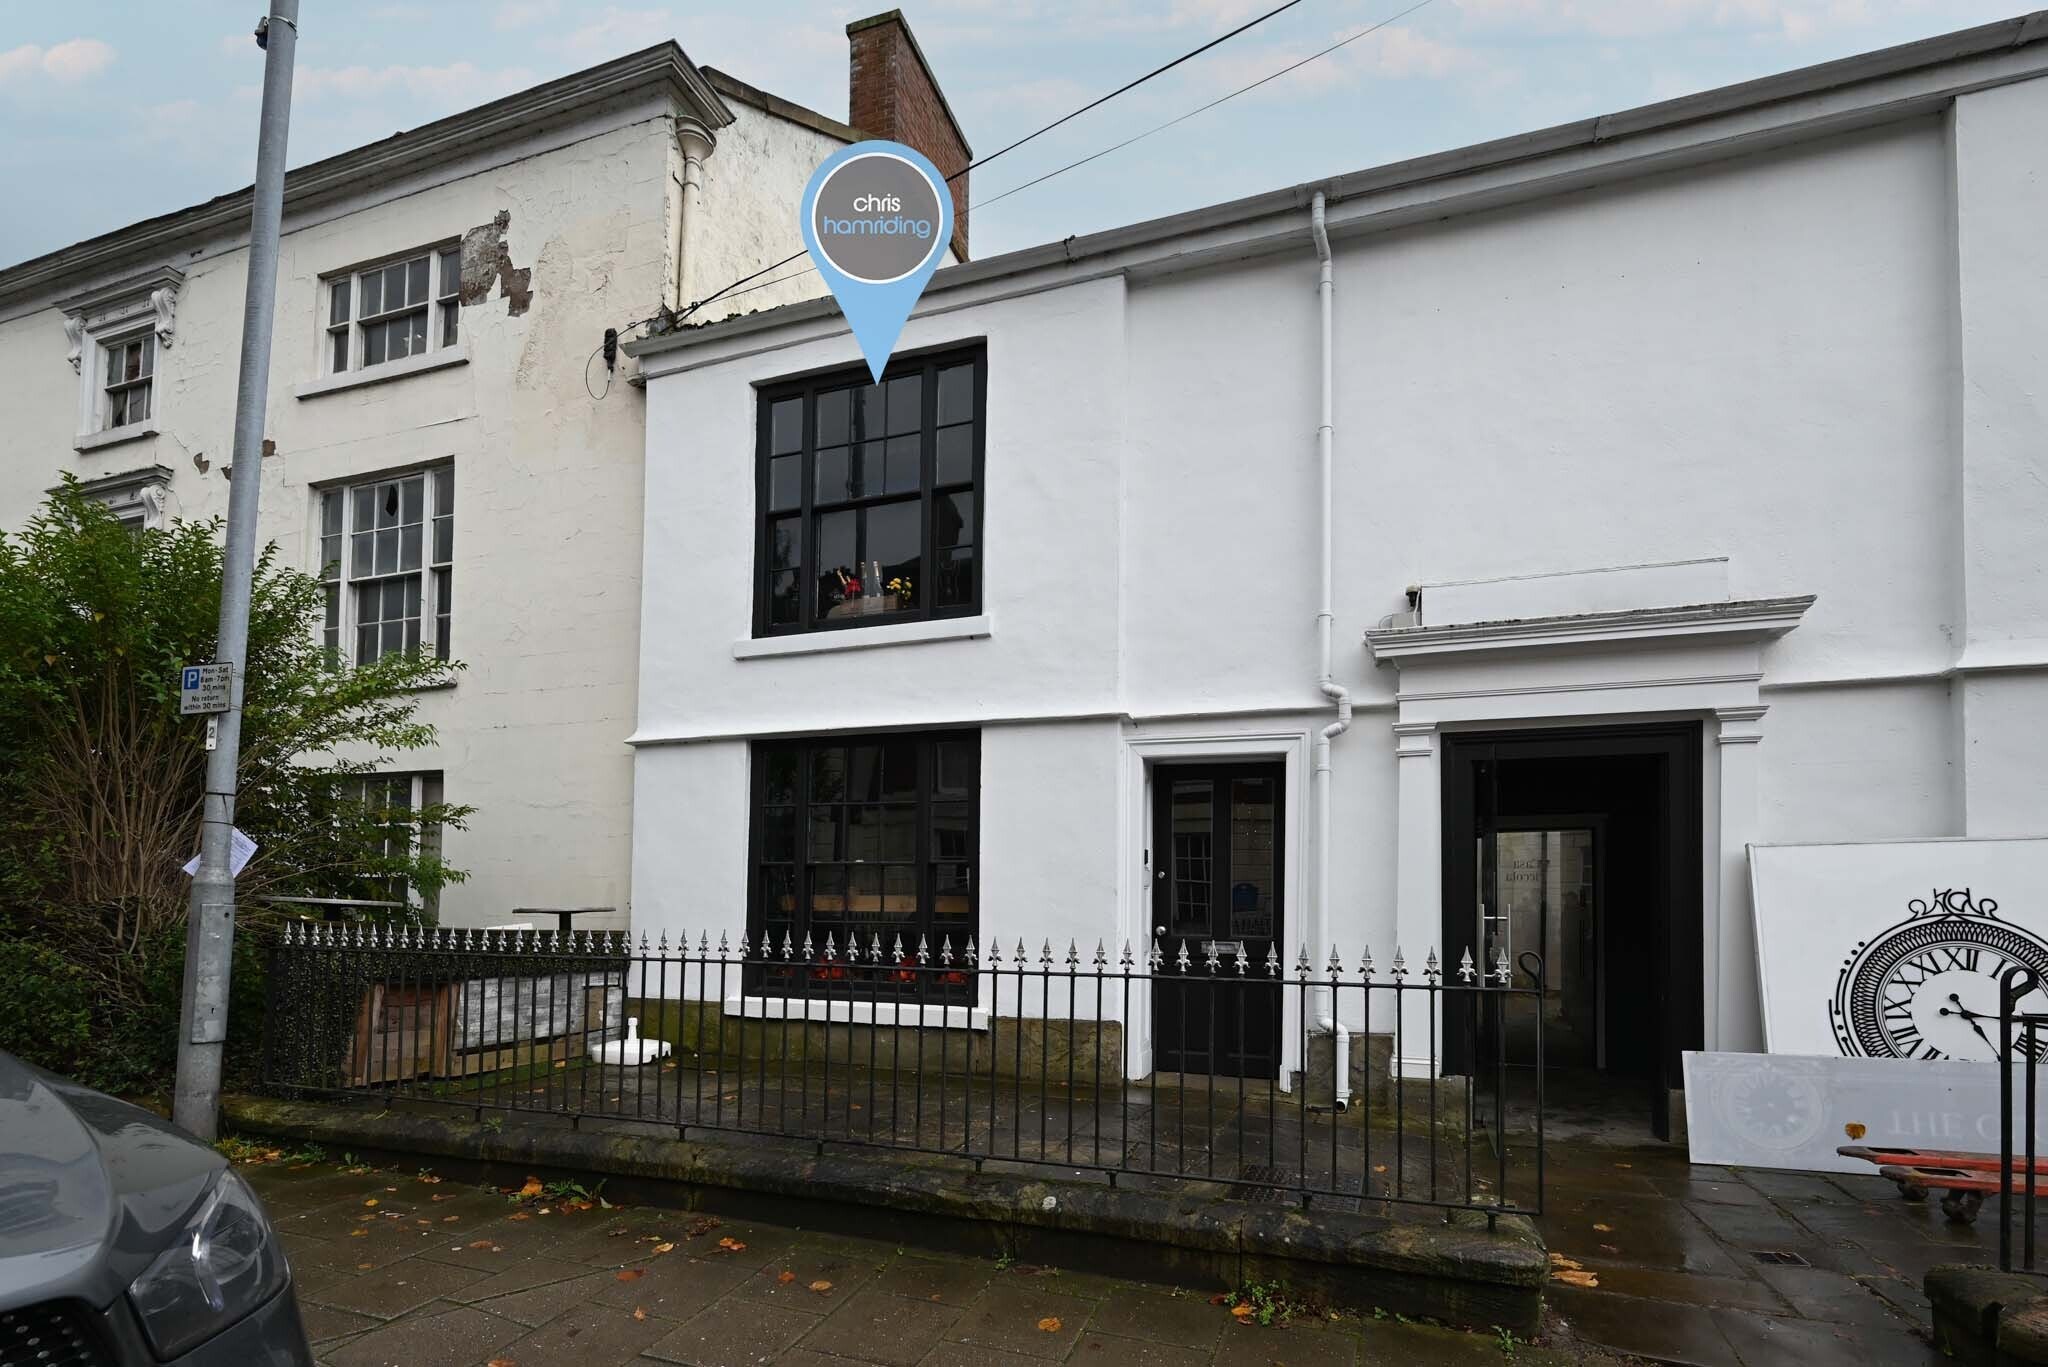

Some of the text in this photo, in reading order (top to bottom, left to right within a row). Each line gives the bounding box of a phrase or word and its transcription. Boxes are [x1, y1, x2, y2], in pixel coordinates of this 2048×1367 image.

[188, 672, 198, 688] P
[202, 684, 211, 692] 30
[192, 695, 200, 703] No
[202, 702, 211, 710] 30
[208, 727, 215, 739] 2
